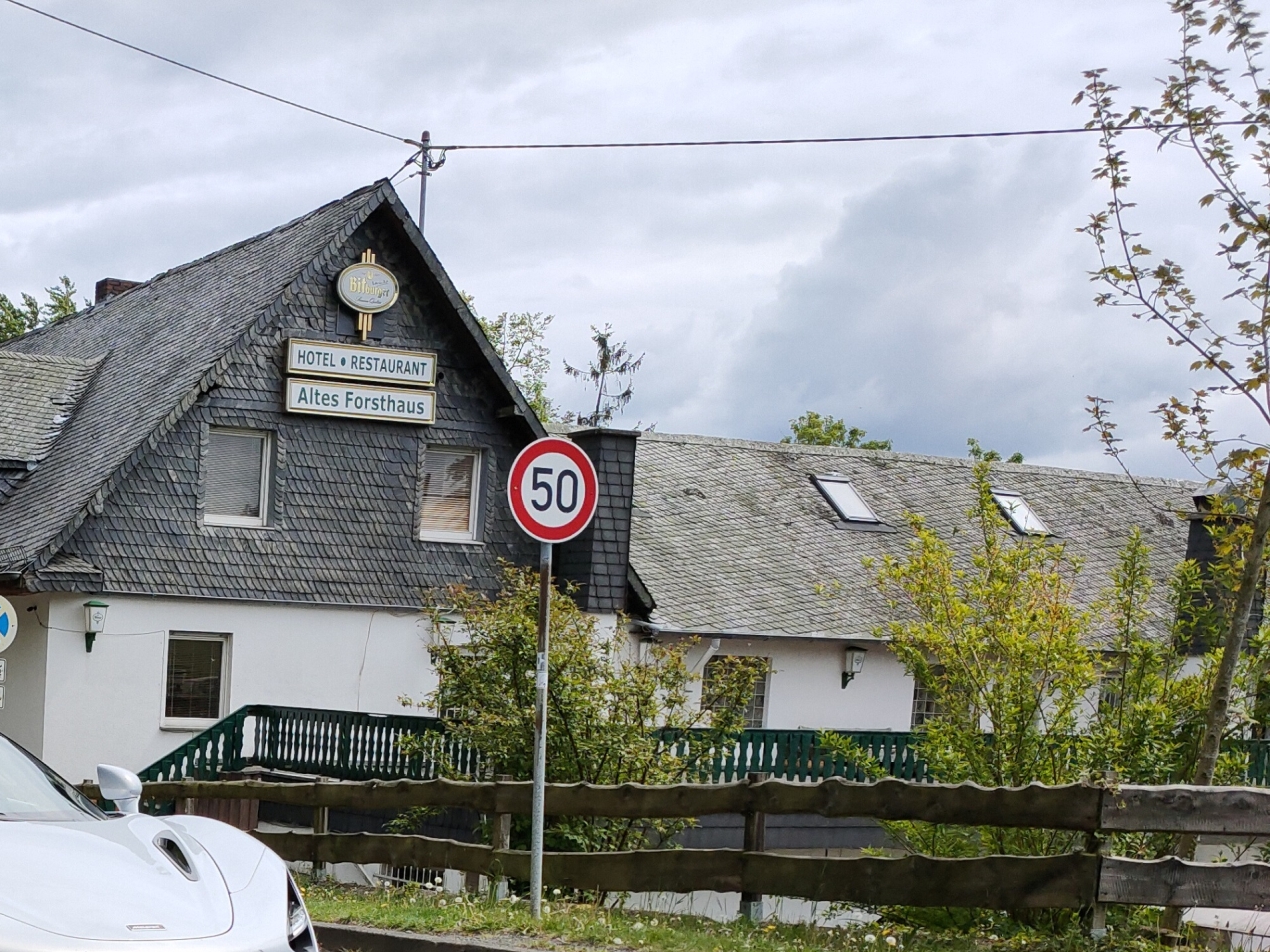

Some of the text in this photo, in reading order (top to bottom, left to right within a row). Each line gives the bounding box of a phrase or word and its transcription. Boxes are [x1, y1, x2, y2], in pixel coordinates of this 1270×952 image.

[297, 350, 428, 377] HOTEL RESTAURANT
[297, 386, 425, 415] Altes Forsthaus
[531, 467, 579, 513] 50
